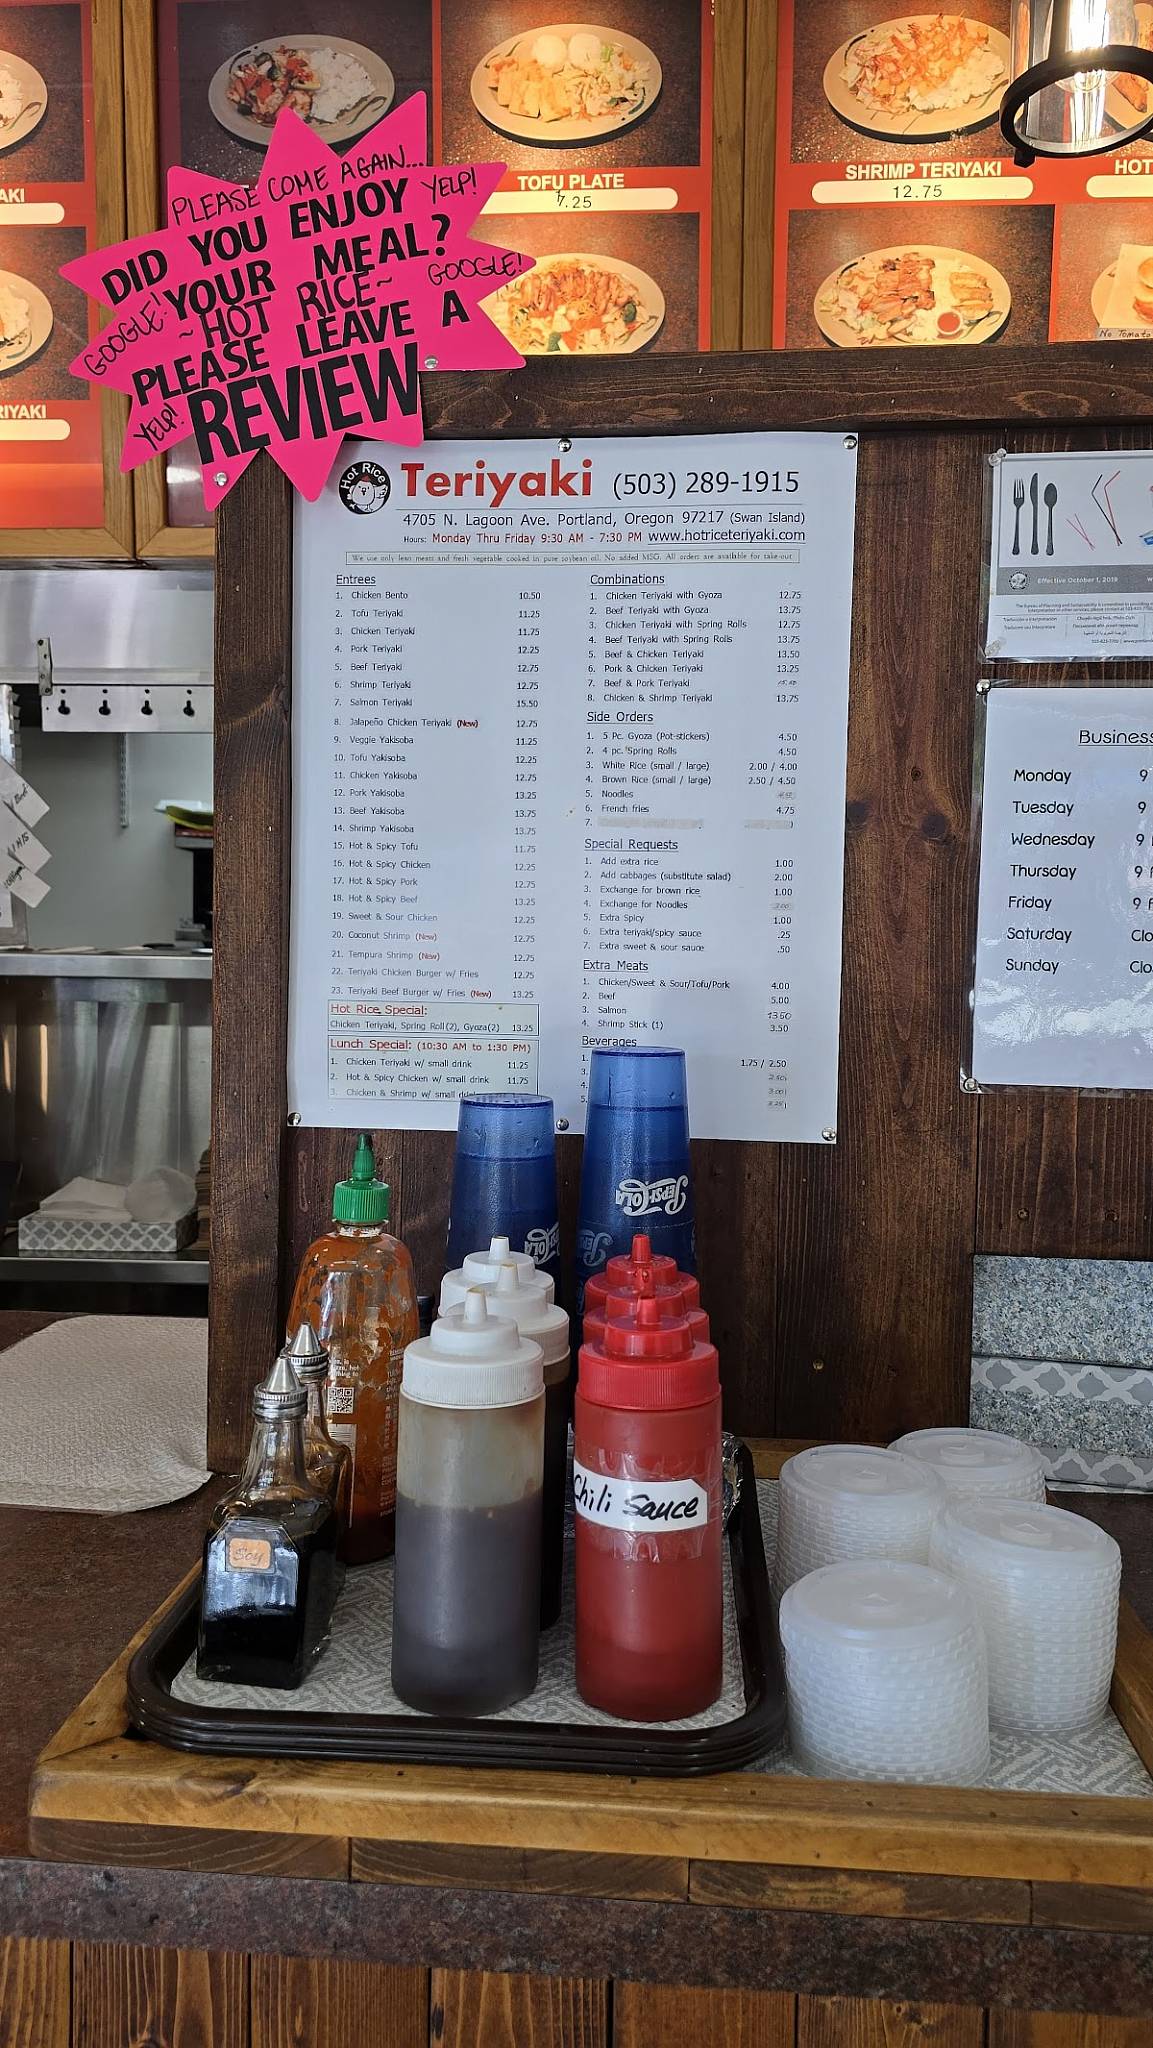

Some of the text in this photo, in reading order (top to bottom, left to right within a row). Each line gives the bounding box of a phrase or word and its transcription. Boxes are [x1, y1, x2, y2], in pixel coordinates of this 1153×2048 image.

[845, 160, 1002, 180] SHRIMP TERIYAKI
[420, 167, 478, 202] YELP!
[518, 174, 624, 190] TOFU PLATE
[172, 186, 261, 227] PLEASE
[267, 164, 328, 202] COME
[892, 184, 943, 199] 12.75
[101, 178, 409, 306] DID YOU ENJOY
[162, 213, 452, 322] YOUR MEAL?
[131, 290, 470, 406] PLEASE LEAVE A
[187, 342, 419, 465] REVIEW
[340, 462, 386, 490] Hot Rice
[401, 459, 592, 507] Teriyaki
[613, 472, 799, 499] (503) 289-1915
[403, 511, 804, 529] 4705 N. Lagoon Ave. Portland, Oregon 97217 (Swan Island)
[433, 533, 471, 545] Monday
[476, 533, 499, 543] Thru
[505, 533, 535, 545] Friday
[541, 532, 563, 543] 9:30
[567, 533, 583, 543] AM
[600, 532, 624, 542] 7:30
[628, 532, 641, 542] PM
[648, 529, 806, 544] www.hotriceteriyaki.com
[336, 575, 376, 585] Entrees
[590, 574, 665, 585] Combinations
[352, 591, 381, 599] Chicken
[386, 591, 408, 599] Bento
[519, 592, 541, 600] 10.50
[606, 591, 637, 600] Chicken
[641, 591, 672, 601] Teriyaki
[677, 590, 694, 599] with
[698, 591, 722, 600] Gyoza
[779, 591, 801, 599] 12.75
[351, 627, 381, 635] Chicken
[385, 627, 415, 636] Teriyaki
[518, 628, 540, 636] 11.75
[589, 634, 800, 645] 4. Beef Teriyaki with Spring Rolls 13.75
[587, 711, 653, 722] Side Orders
[380, 736, 413, 744] Yakisoba
[516, 738, 538, 746] 11.25
[1079, 730, 1153, 744] Business
[1014, 769, 1148, 784] Monday 9
[602, 804, 628, 813] French
[632, 804, 649, 813] fries
[776, 806, 795, 815] 4.75
[1012, 801, 1146, 816] Tuesday 9
[584, 839, 678, 850] Special Requests
[1011, 833, 1144, 848] Wednesday 9
[1010, 864, 1142, 880] Thursday 9
[600, 886, 637, 895] Exchange
[642, 886, 652, 894] for
[657, 887, 681, 895] brown
[685, 887, 700, 895] rice
[774, 888, 793, 896] 1.00
[1008, 896, 1141, 912] Friday 9
[1007, 928, 1072, 943] Saturday
[583, 960, 648, 971] Extra Meats
[1006, 959, 1060, 974] Sunday
[349, 987, 378, 996] Teriyaki
[382, 988, 399, 996] Beef
[403, 988, 429, 997] Burger
[447, 989, 465, 997] Fries
[470, 990, 492, 999] (New)
[331, 1005, 351, 1014] Hot
[385, 1006, 428, 1016] Special:
[598, 1020, 625, 1029] Shrimp
[629, 1021, 647, 1029] Stick
[652, 1021, 663, 1030] (1)
[770, 1024, 789, 1032] 3.50
[330, 1039, 363, 1048] Lunch
[369, 1040, 412, 1050] Special:
[417, 1042, 447, 1051] (10:30
[452, 1043, 467, 1051] AM
[472, 1043, 481, 1051] to
[513, 1044, 531, 1053] PM)
[582, 1036, 637, 1047] Beverages
[347, 1058, 376, 1066] Chicken
[381, 1058, 410, 1067] Teriyaki
[415, 1059, 425, 1067] w/
[428, 1060, 449, 1068] small
[452, 1060, 472, 1068] drink
[573, 1473, 698, 1519] Chili Sauce
